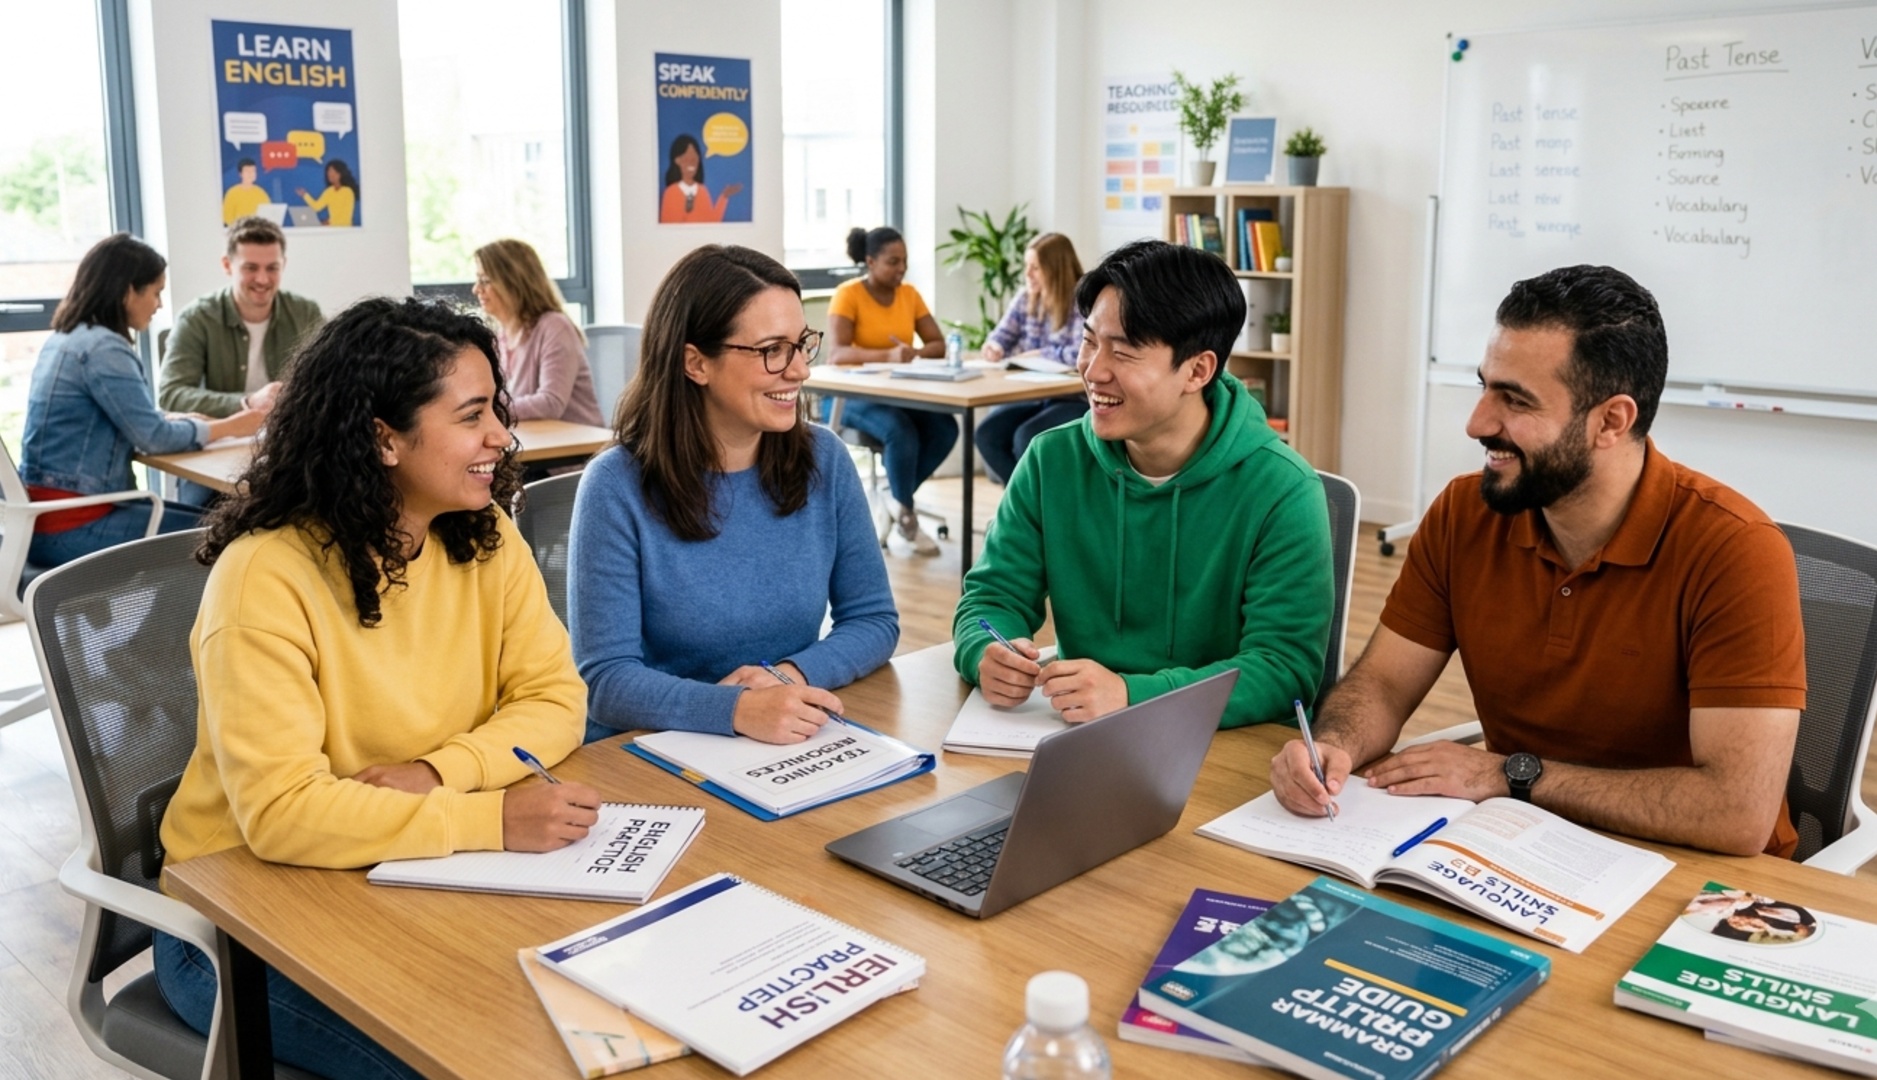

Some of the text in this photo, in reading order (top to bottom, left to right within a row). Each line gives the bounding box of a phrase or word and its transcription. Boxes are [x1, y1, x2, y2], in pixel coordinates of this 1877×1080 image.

[237, 33, 331, 62] LEARN
[1665, 41, 1783, 71] Past Tense
[224, 59, 346, 88] ENGLISH
[658, 62, 715, 84] SPEAK
[1491, 102, 1523, 123] Past
[1491, 132, 1521, 150] Past
[1489, 160, 1521, 177] Last
[1667, 168, 1721, 187] Source
[1488, 188, 1520, 205] Last
[1665, 195, 1748, 224] Vocabulary
[1664, 225, 1751, 260] Vocabulary
[1676, 969, 1860, 1029] LANGUAGE
[1723, 967, 1836, 1005] SKILLS
[1332, 976, 1454, 1031] GUIDE
[1271, 996, 1415, 1062] GRAMMAR
